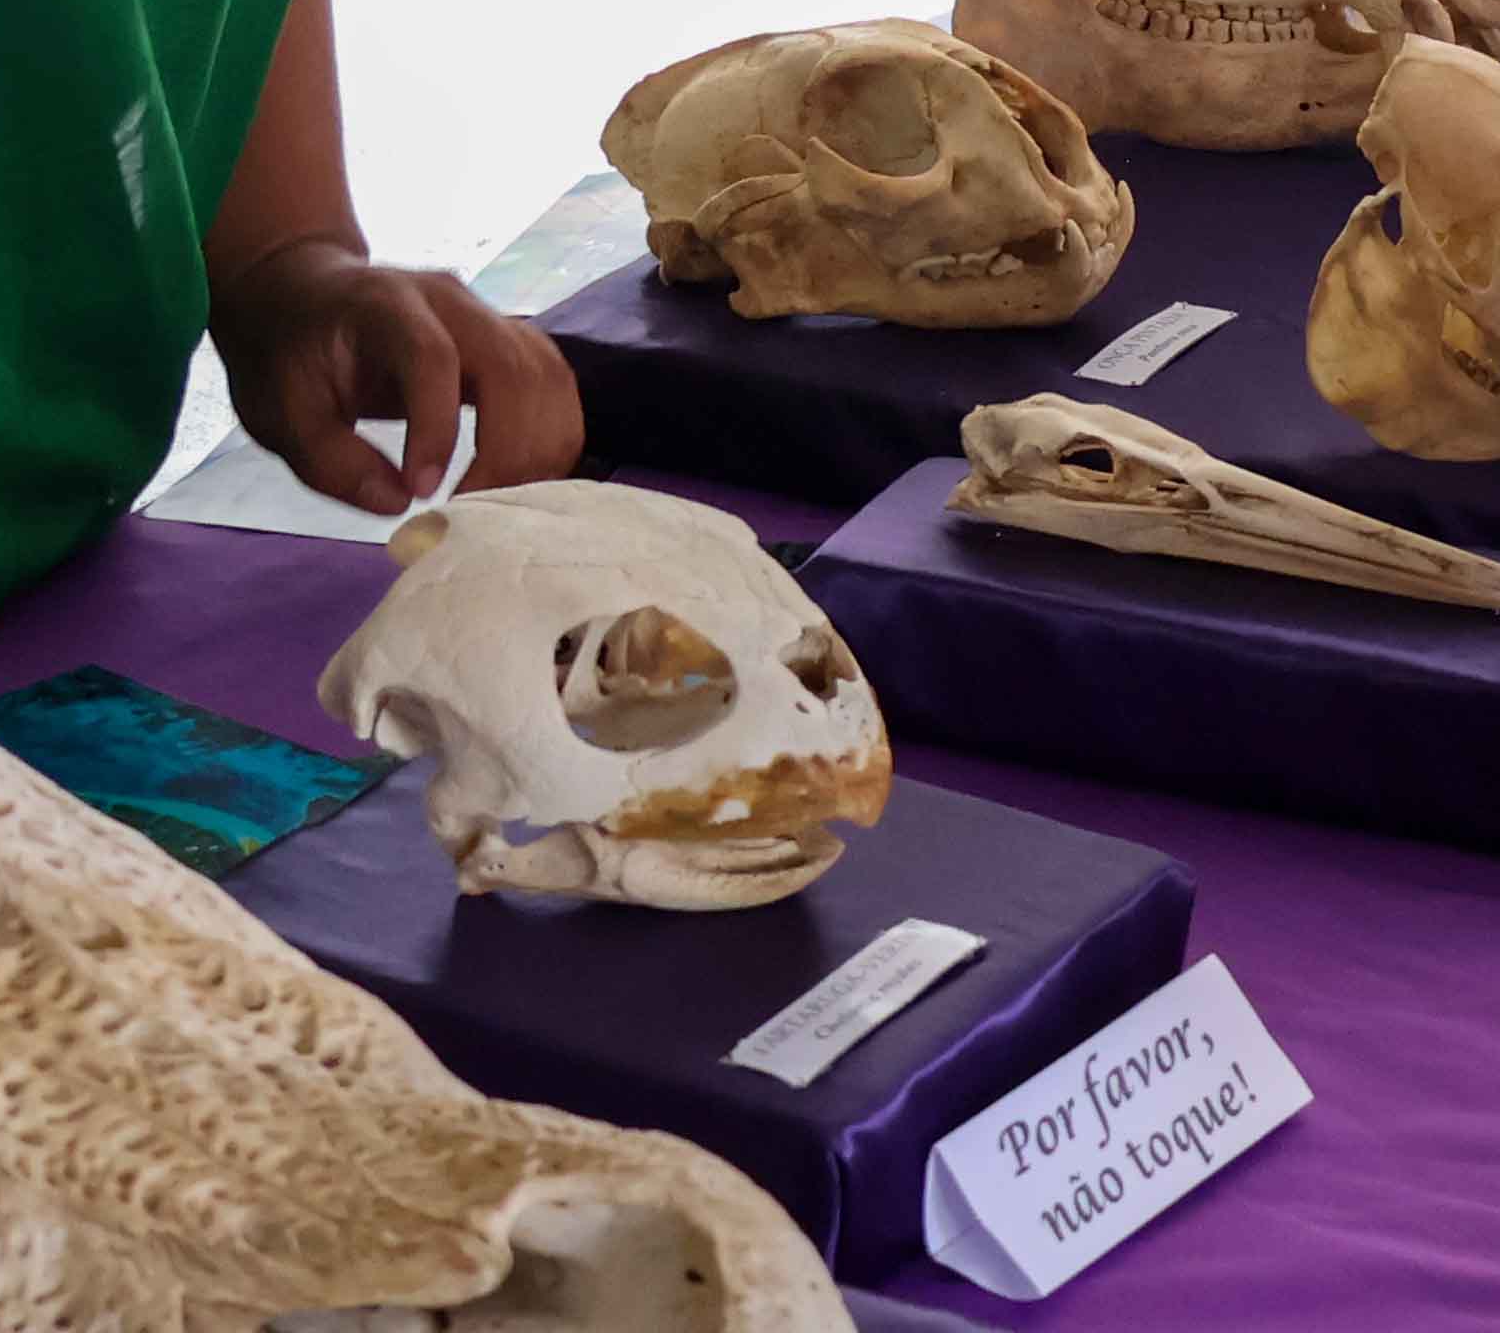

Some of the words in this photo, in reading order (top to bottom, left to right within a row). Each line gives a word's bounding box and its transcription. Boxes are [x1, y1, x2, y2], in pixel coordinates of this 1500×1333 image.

[998, 1100, 1080, 1179] Por
[1082, 1016, 1217, 1150] favor,
[1040, 1173, 1127, 1243] não
[1125, 1060, 1261, 1166] toque!
